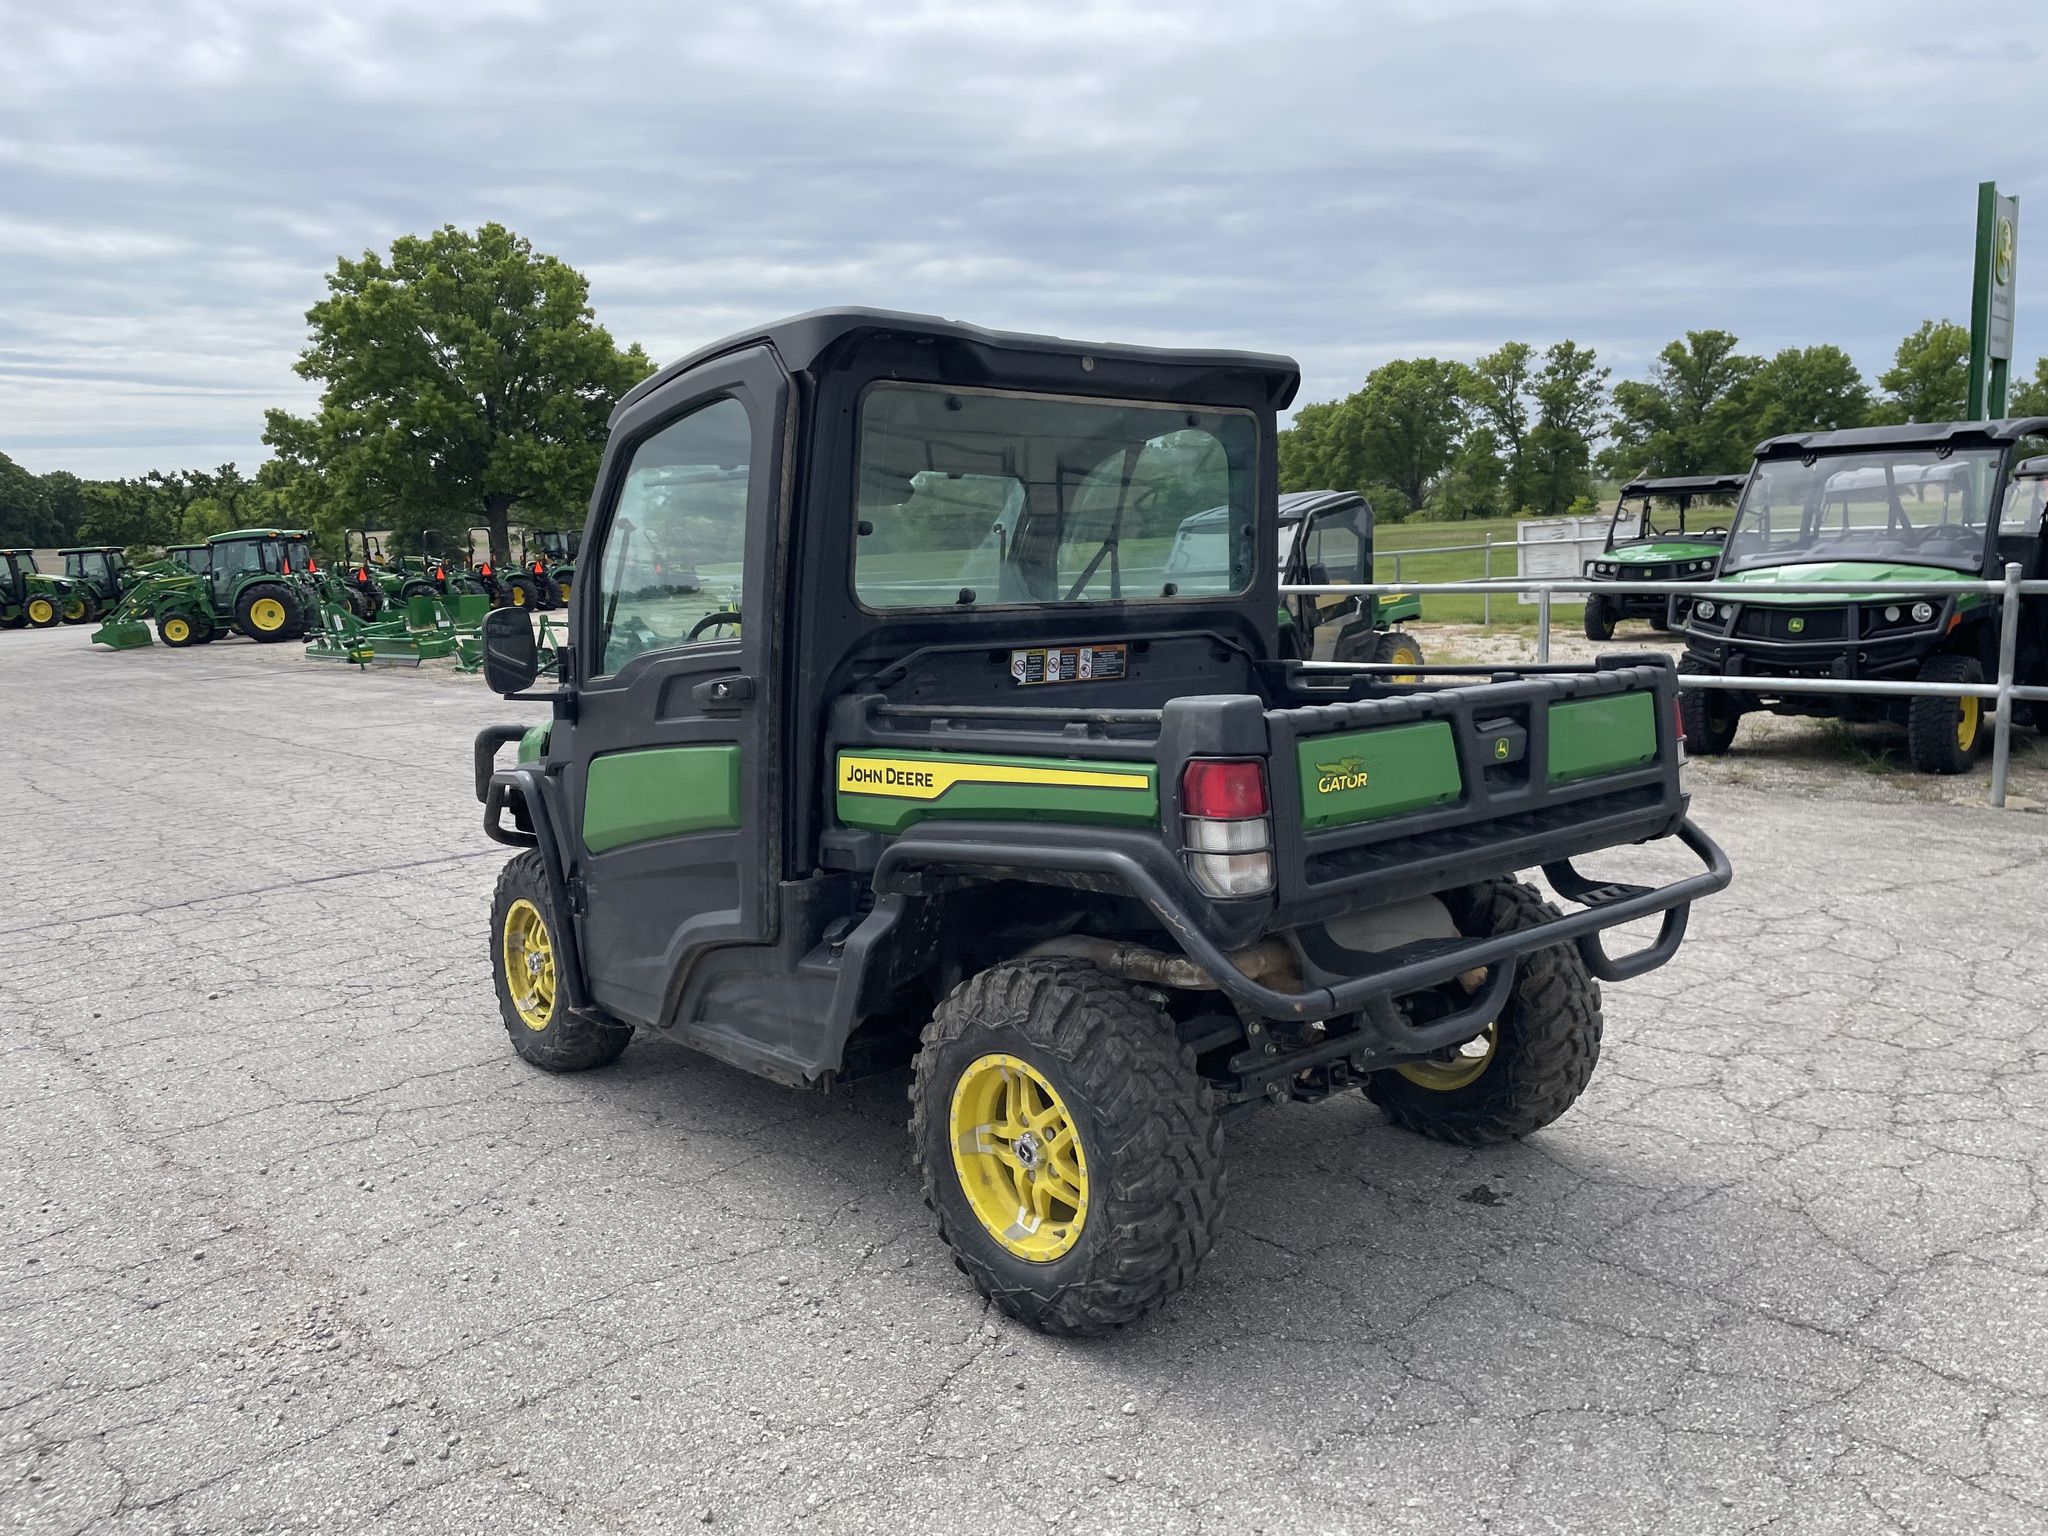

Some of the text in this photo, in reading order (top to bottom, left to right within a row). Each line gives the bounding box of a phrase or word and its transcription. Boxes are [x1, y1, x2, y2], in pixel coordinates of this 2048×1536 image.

[847, 765, 934, 788] JOHN DEERE
[1318, 772, 1368, 793] GATOR
